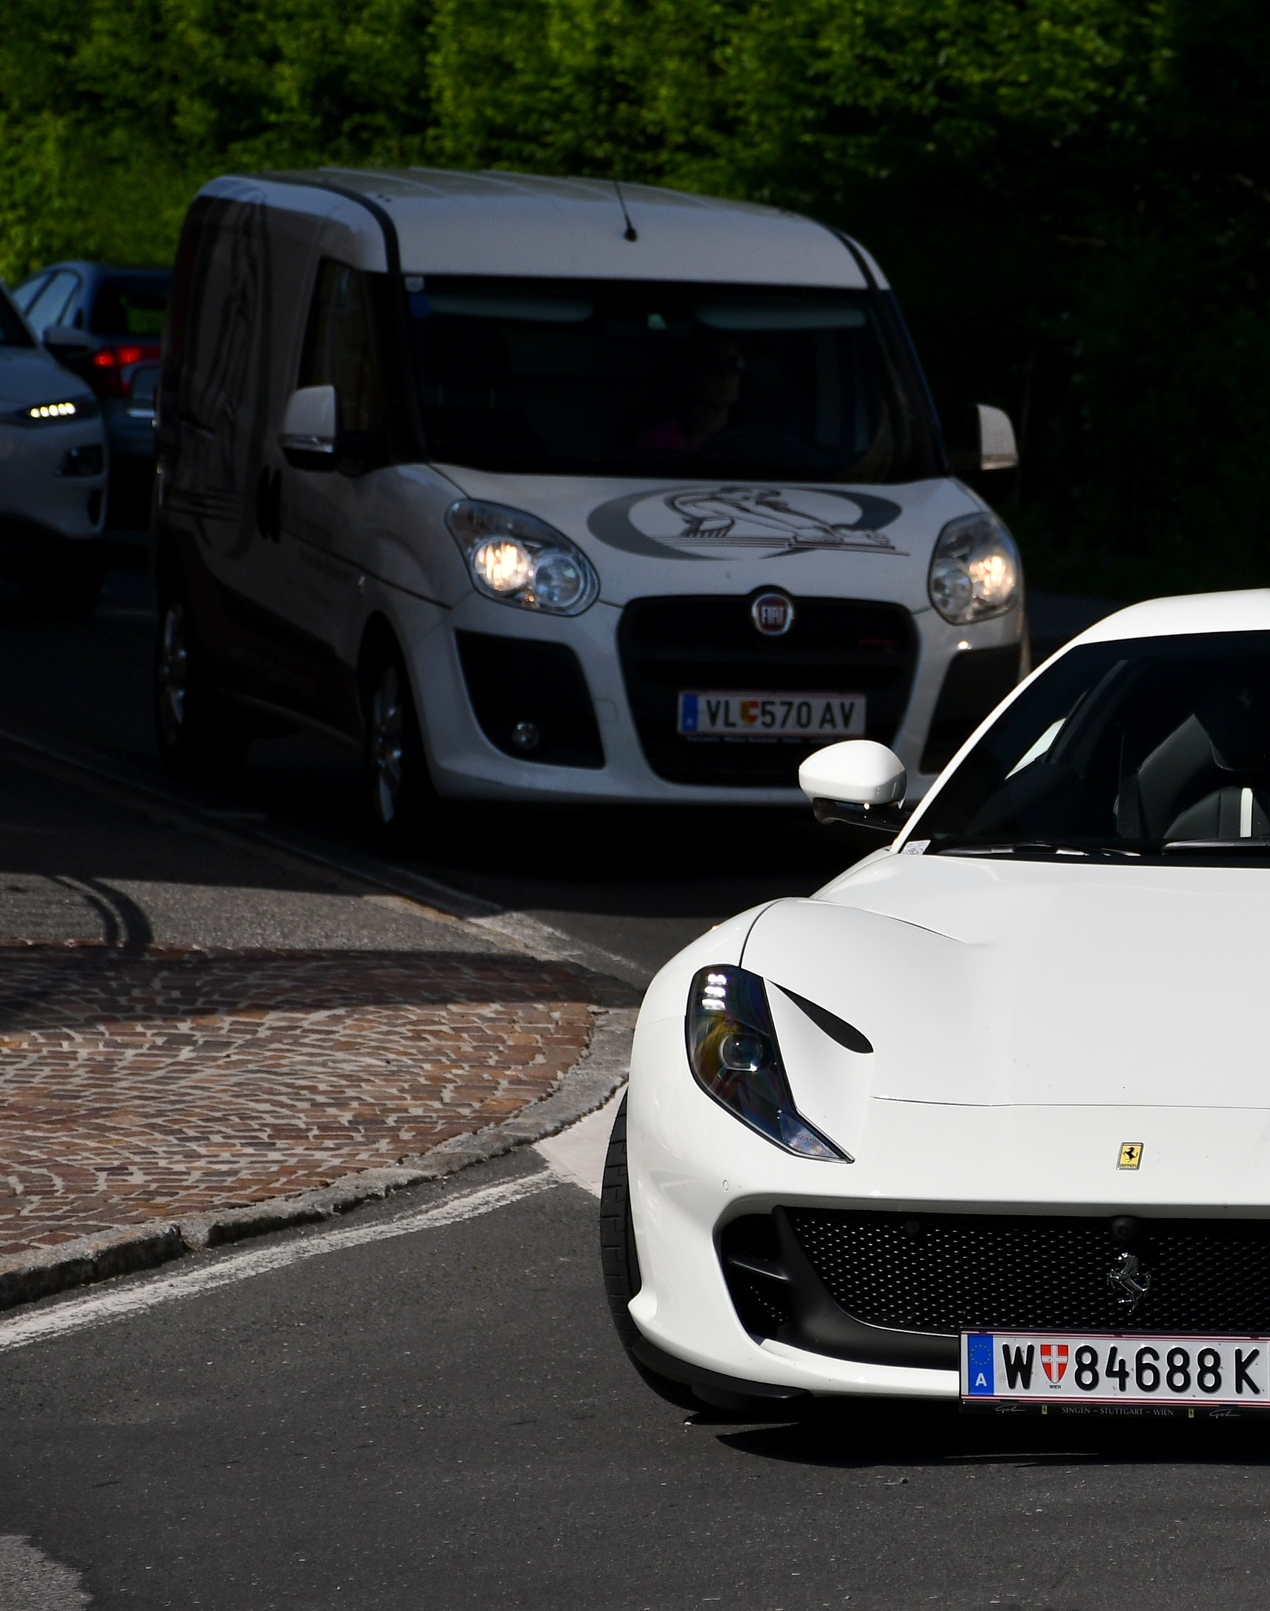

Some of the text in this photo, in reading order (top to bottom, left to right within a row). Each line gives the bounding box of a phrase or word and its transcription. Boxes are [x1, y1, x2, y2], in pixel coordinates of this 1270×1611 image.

[761, 605, 784, 625] FIAT
[706, 700, 855, 729] VL 570 AV
[1002, 1342, 1261, 1395] W 84688 K
[975, 1373, 988, 1387] A
[1061, 1406, 1091, 1414] SINGEN
[1100, 1407, 1143, 1416] STUTTGART
[1153, 1408, 1174, 1416] WIEN
